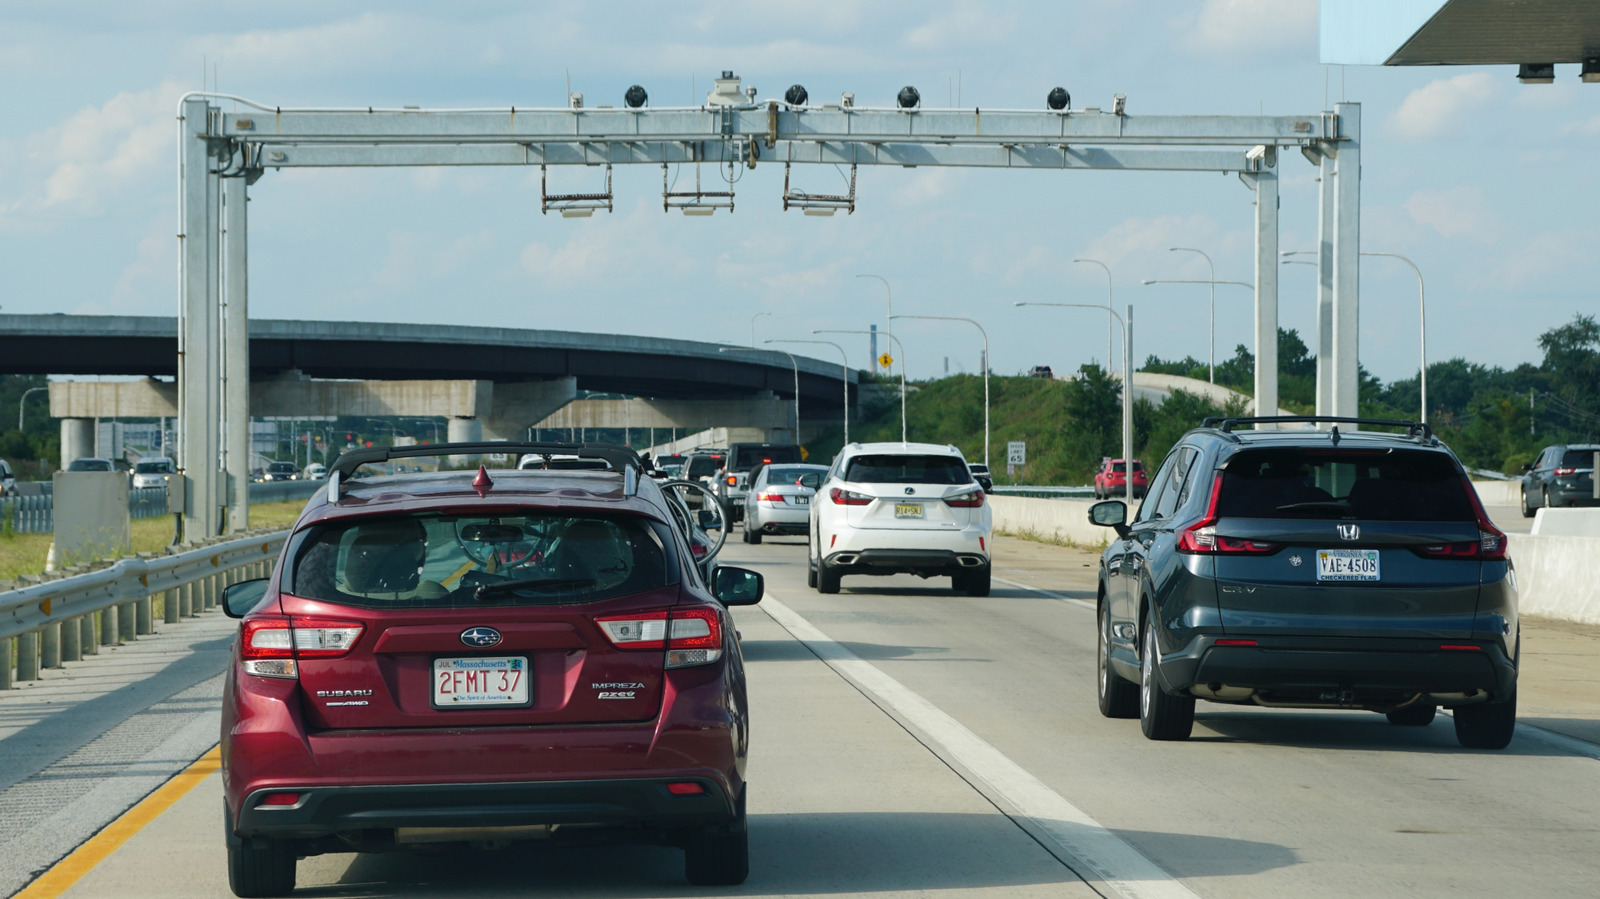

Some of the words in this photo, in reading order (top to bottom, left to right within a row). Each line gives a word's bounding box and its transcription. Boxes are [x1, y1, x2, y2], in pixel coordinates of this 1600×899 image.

[1321, 558, 1376, 573] VAE-4508
[455, 659, 507, 668] Massachusetts
[316, 689, 372, 697] SUBARU
